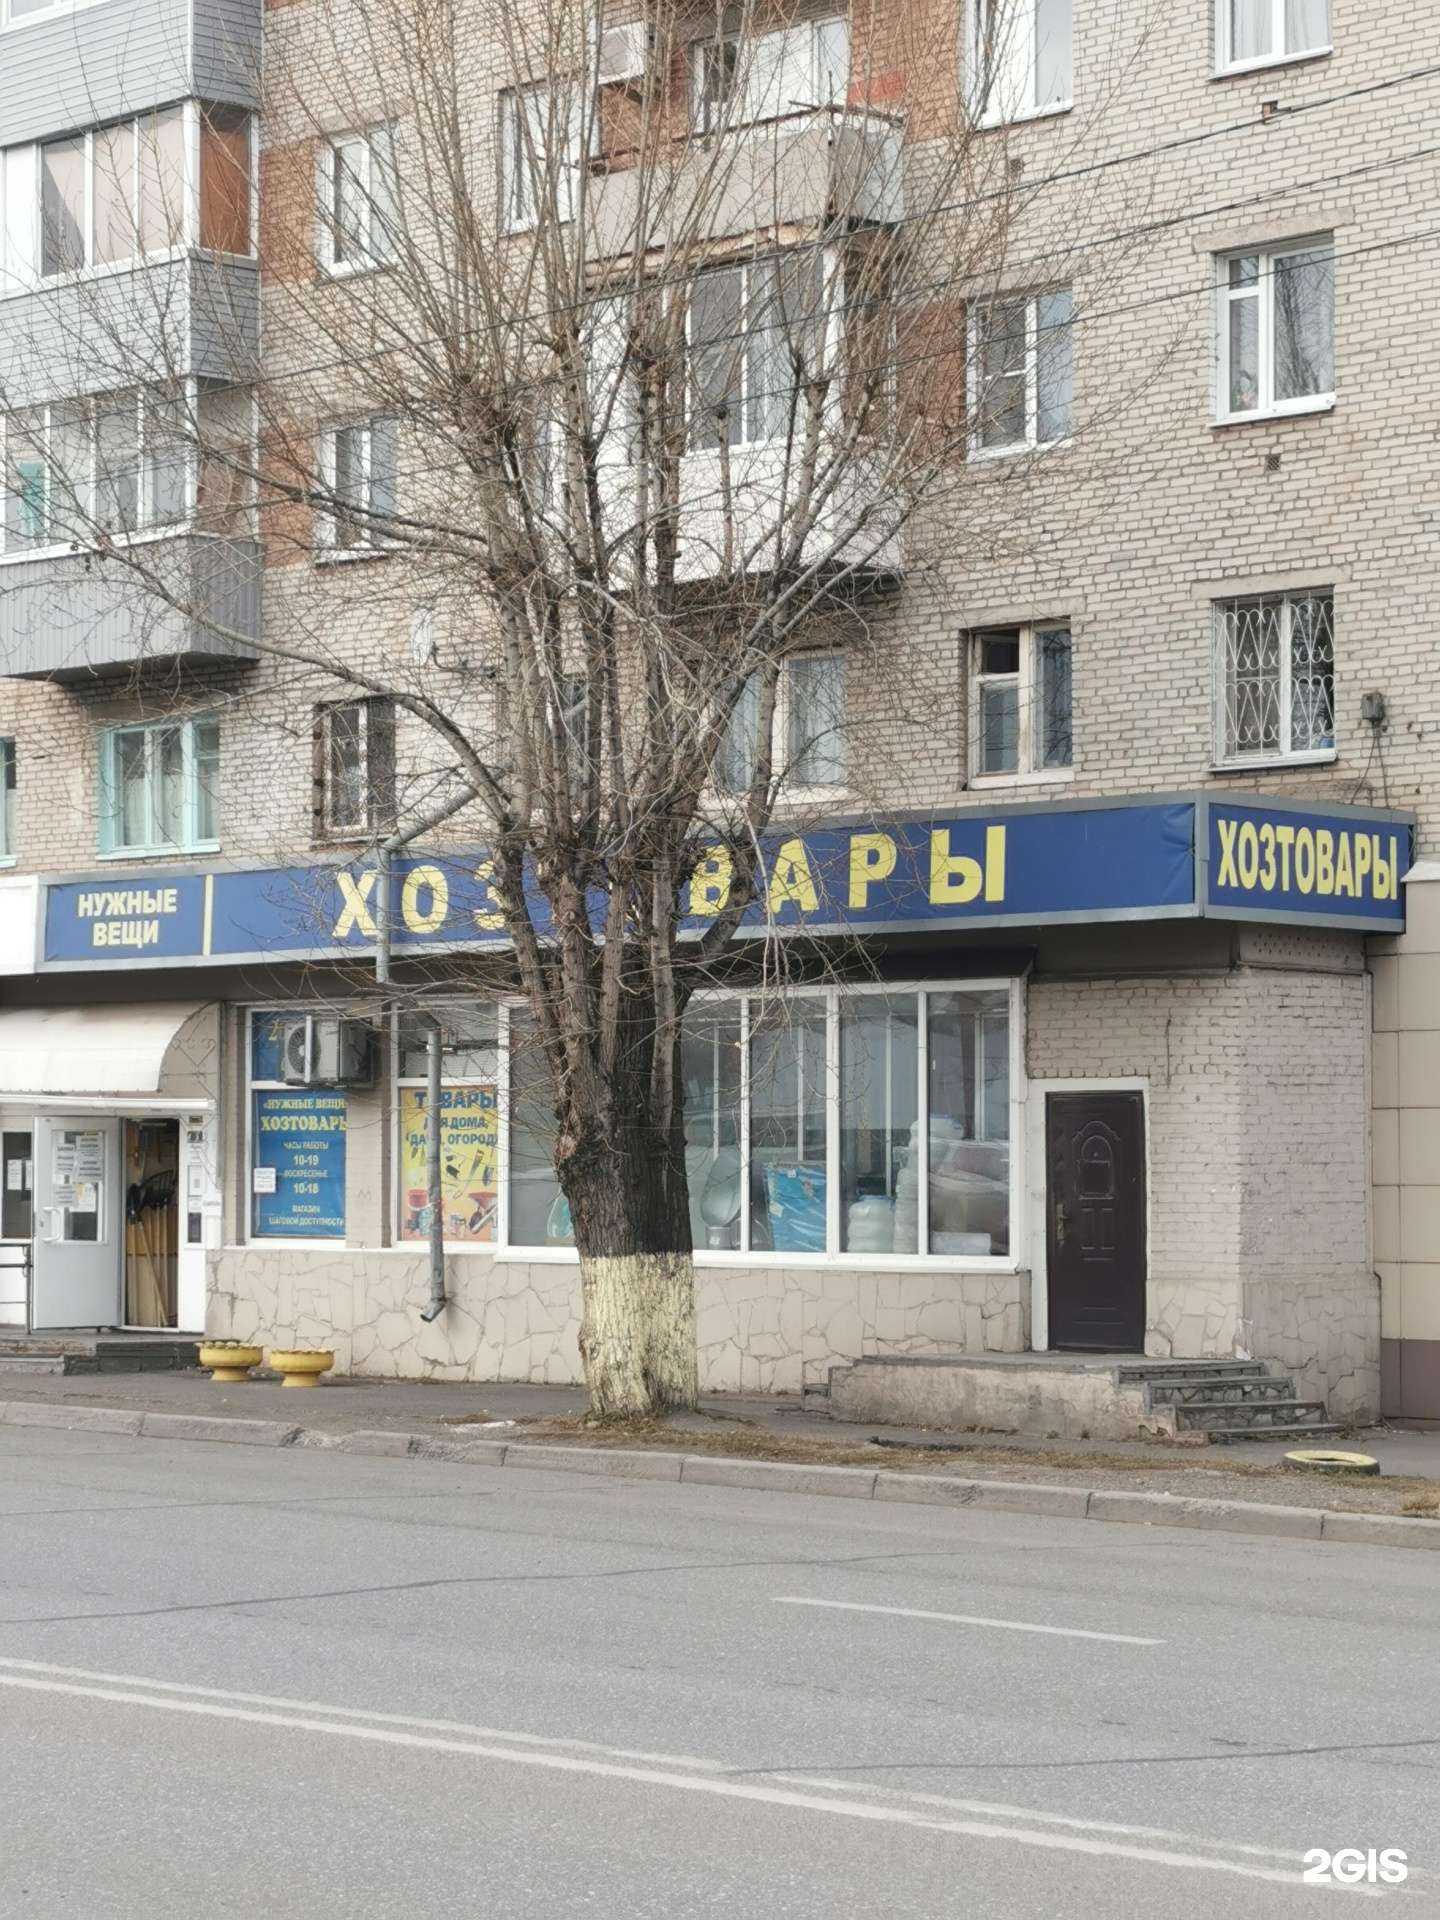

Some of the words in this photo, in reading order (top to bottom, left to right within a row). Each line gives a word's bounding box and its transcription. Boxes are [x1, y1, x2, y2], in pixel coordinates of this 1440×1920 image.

[1217, 819, 1398, 900] ХОЗТОВАРЫ
[332, 825, 1007, 938] ХОЗВАРЫ
[77, 888, 178, 917] НУЖНЫЕ
[92, 920, 159, 948] ВЕЩИ
[414, 1091, 498, 1109] ТВАРЫ
[293, 1154, 320, 1166] 10-19
